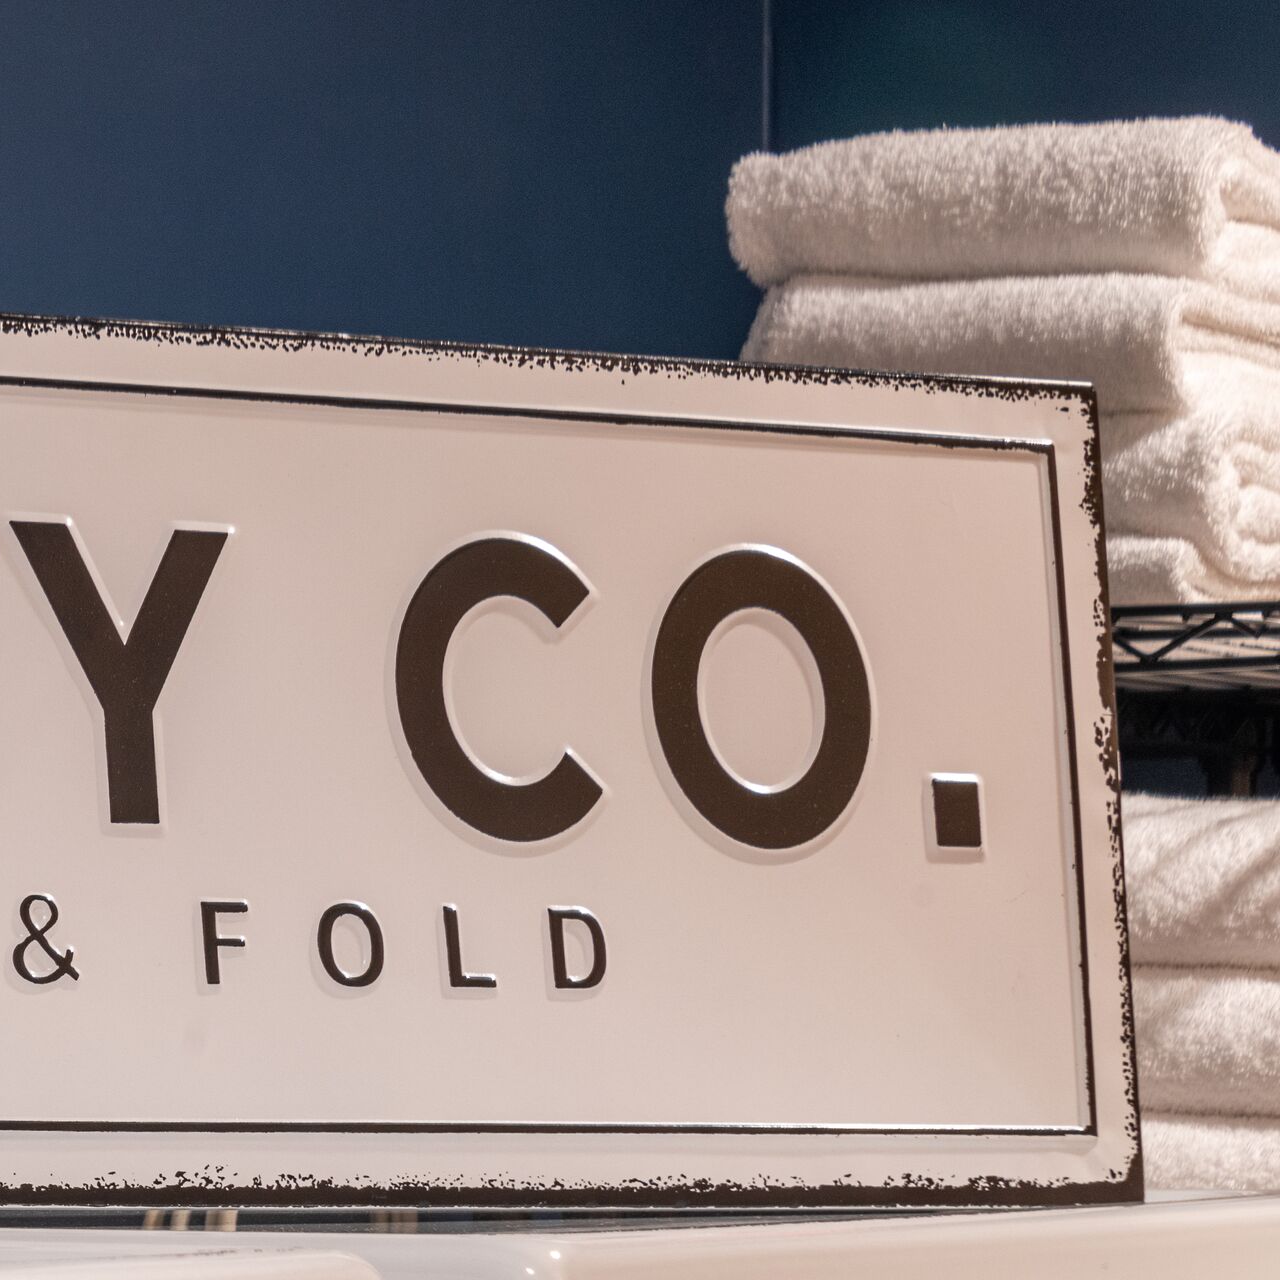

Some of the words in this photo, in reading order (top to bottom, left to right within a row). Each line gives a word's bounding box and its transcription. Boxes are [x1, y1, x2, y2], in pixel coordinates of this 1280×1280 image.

[397, 536, 982, 850] CO.
[13, 892, 80, 984] &
[200, 899, 608, 990] FOLD
